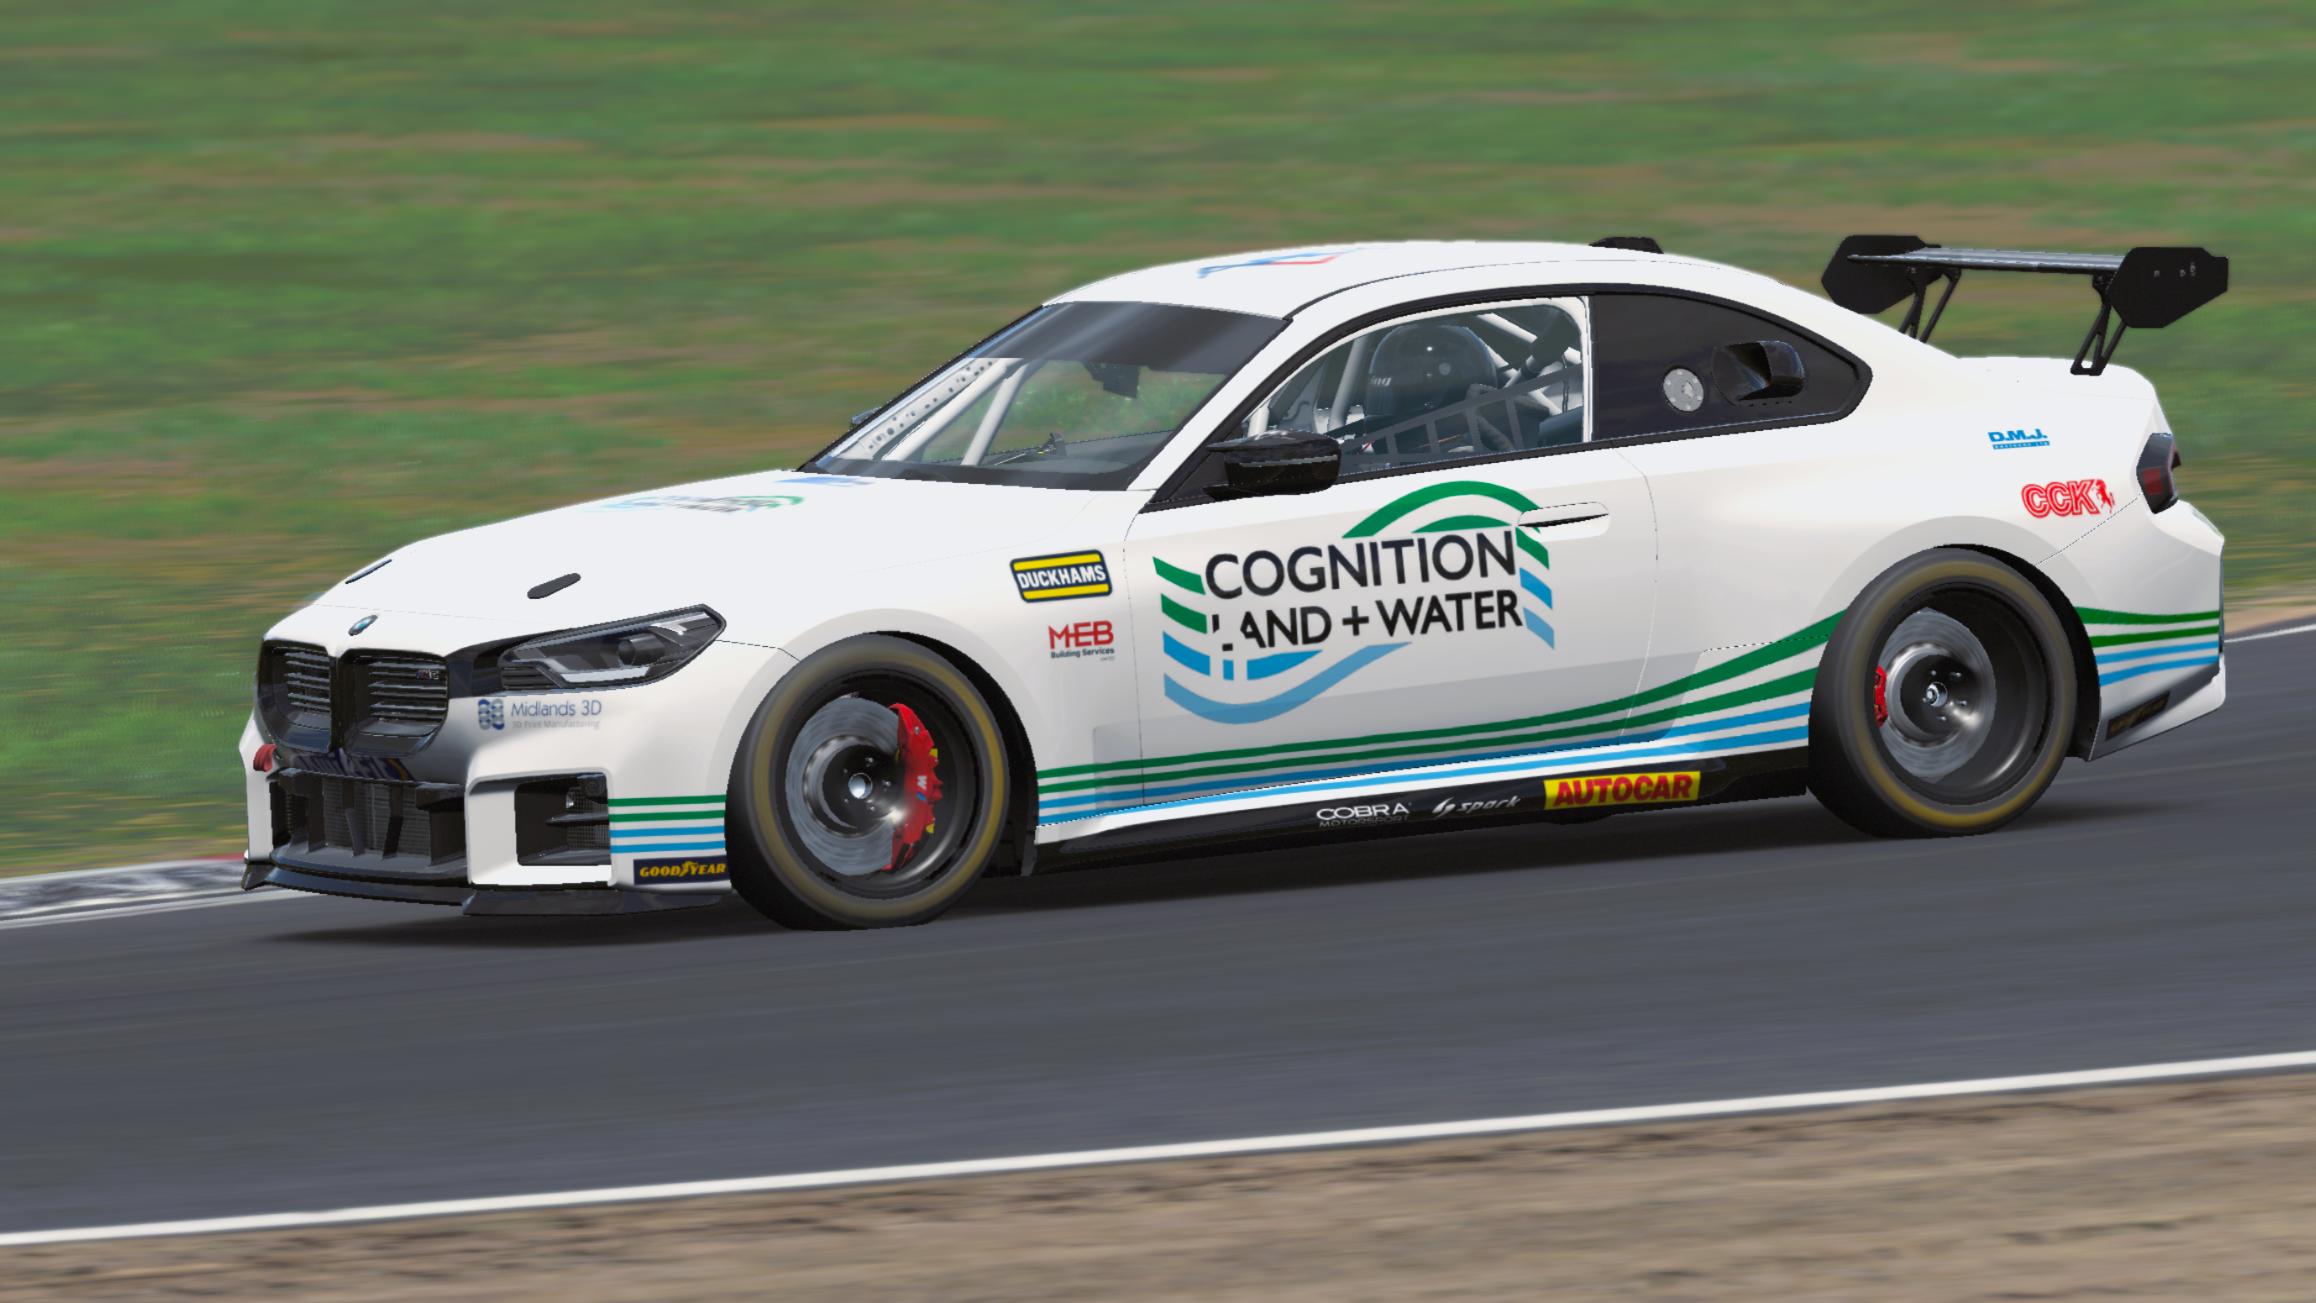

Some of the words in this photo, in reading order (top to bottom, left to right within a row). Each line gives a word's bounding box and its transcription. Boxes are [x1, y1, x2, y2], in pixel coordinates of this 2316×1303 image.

[2021, 479, 2100, 518] CCK
[1017, 564, 1106, 589] DUCKHAMS
[1205, 531, 1516, 600] COGNITION
[1375, 589, 1523, 637] WATER
[1047, 620, 1115, 649] MEB
[1050, 650, 1081, 659] Building
[1082, 648, 1115, 656] Services
[511, 701, 576, 717] Midlands
[581, 699, 602, 716] 3D
[1553, 774, 1693, 807] AUTOCAR
[1316, 803, 1410, 821] COBRA
[1457, 795, 1521, 814] spark
[639, 861, 727, 877] GOODYEAR
